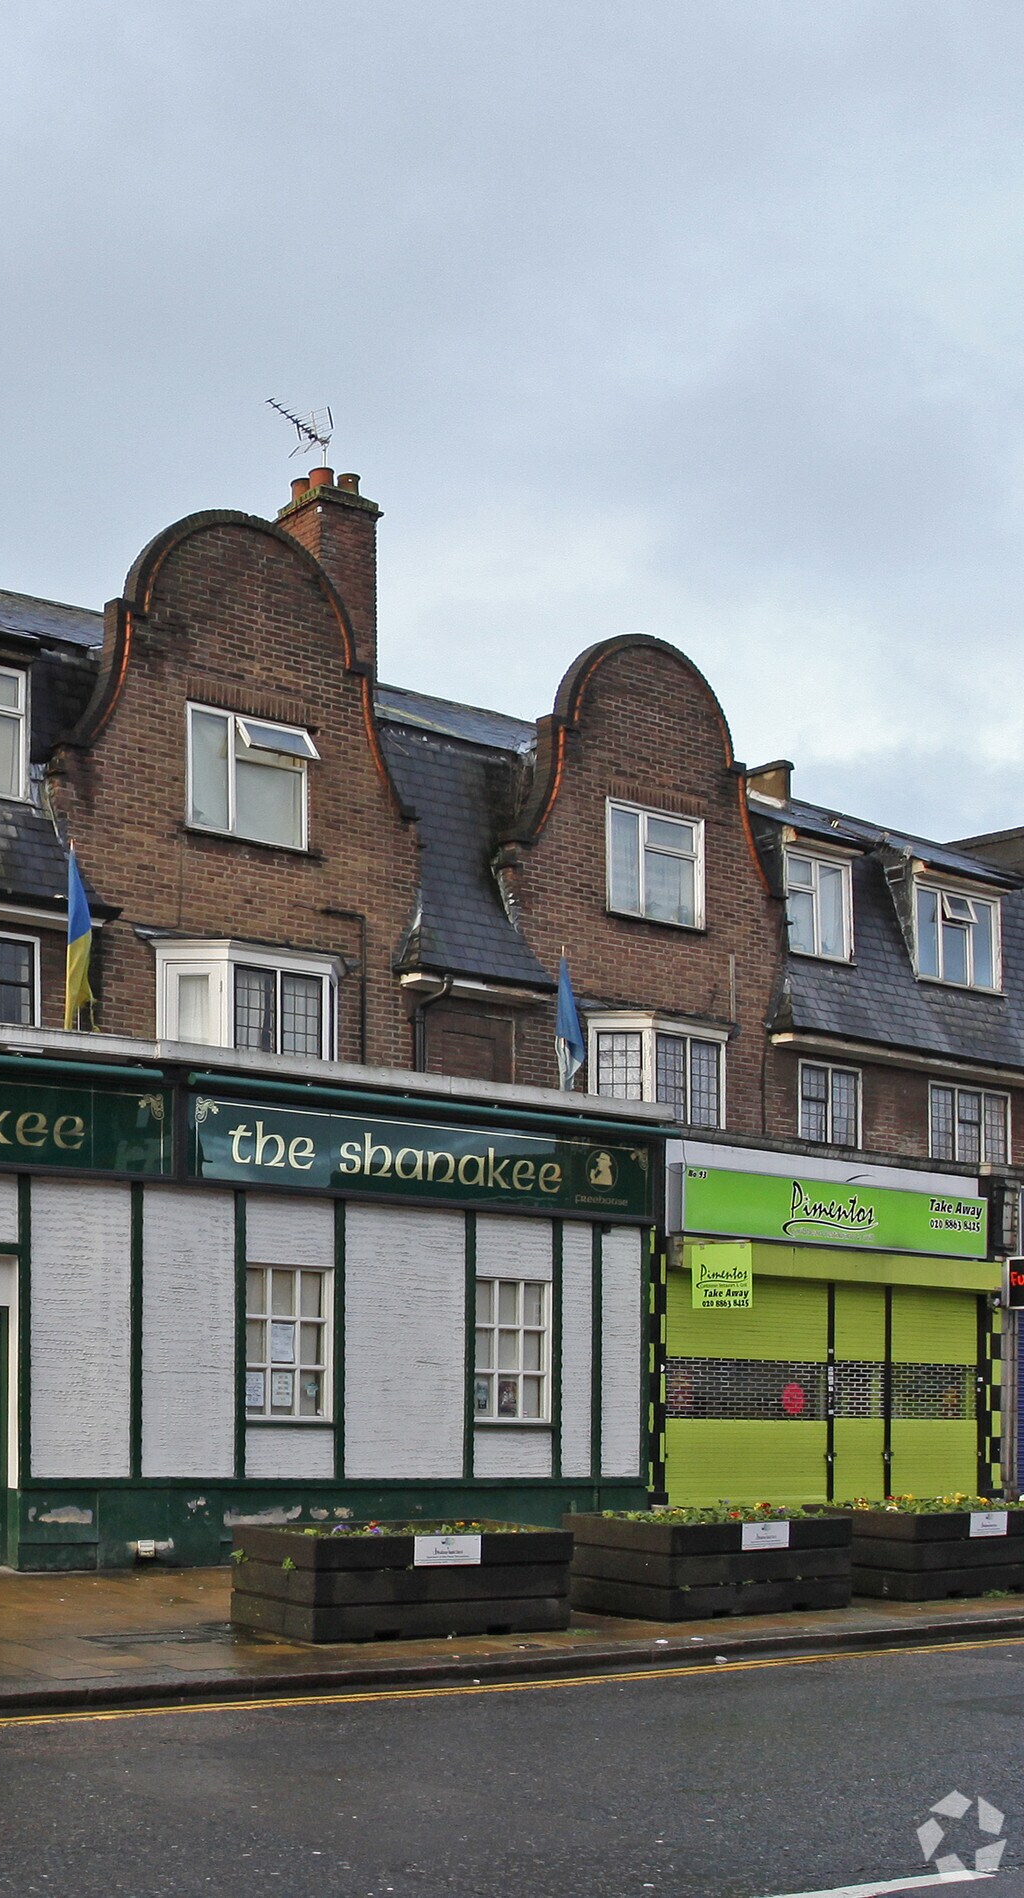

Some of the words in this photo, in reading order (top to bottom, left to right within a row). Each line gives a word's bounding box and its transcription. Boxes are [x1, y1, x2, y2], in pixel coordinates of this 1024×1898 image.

[228, 1120, 317, 1171] the
[339, 1132, 563, 1194] shanakee
[789, 1180, 875, 1226] Pimentos
[929, 1198, 954, 1214] Take
[954, 1201, 983, 1220] Away
[929, 1219, 943, 1229] 020
[700, 1263, 748, 1281] Pimentos
[703, 1289, 724, 1298] Take
[725, 1288, 750, 1300] Away
[701, 1300, 714, 1308] 020
